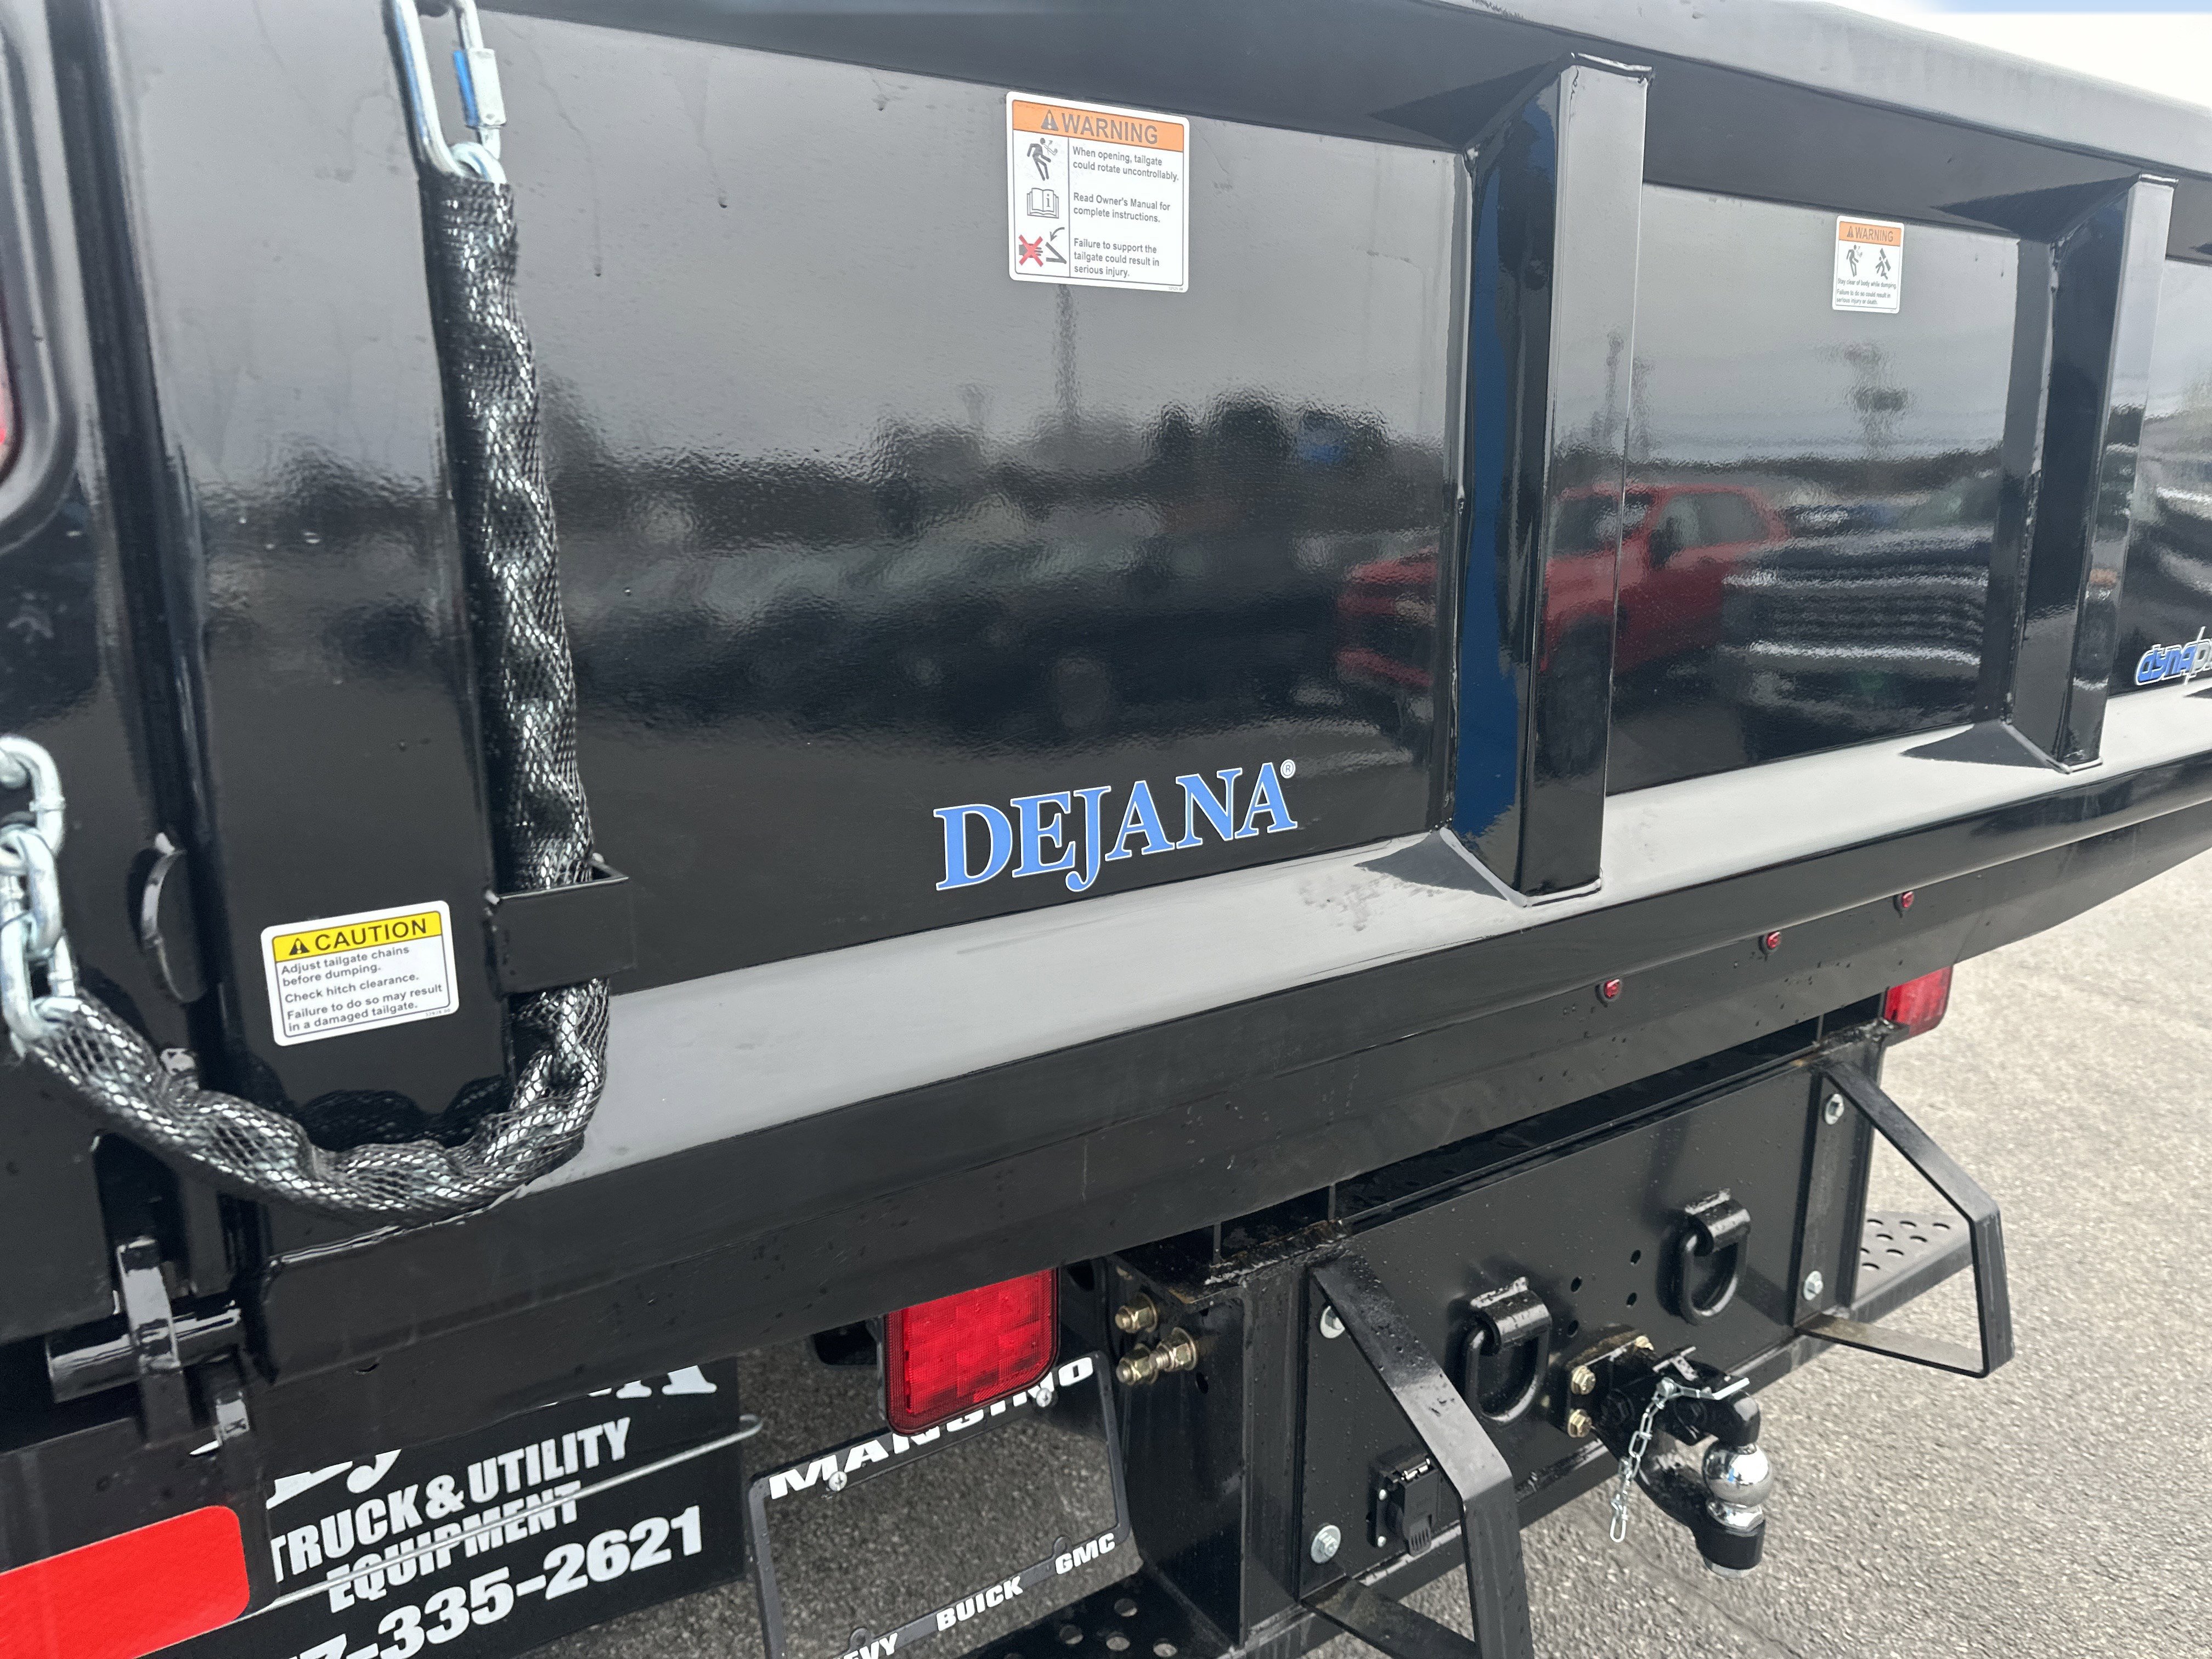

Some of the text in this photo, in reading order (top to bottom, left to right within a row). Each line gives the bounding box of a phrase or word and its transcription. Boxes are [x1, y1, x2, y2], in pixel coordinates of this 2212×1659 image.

[1061, 112, 1158, 144] WARNING
[1073, 146, 1162, 166] When opening, tailgate
[1073, 162, 1178, 182] could rotate uncontrollably.
[1074, 193, 1170, 211] Read Owner's Manual for
[1074, 207, 1160, 222] complete instructions.
[1074, 238, 1101, 249] Failure
[1113, 244, 1143, 253] support
[1145, 245, 1156, 253] the
[1855, 227, 1894, 242] WARNING
[1074, 251, 1159, 266] tailgate could result in
[1074, 266, 1129, 278] serious injury.
[315, 918, 426, 950] CAUTION
[281, 947, 409, 975] Adjust tailgate chains
[283, 964, 381, 987] before dumping.
[285, 974, 419, 1003] Check hitch clearance.
[287, 984, 442, 1020] Failure to do so may result
[289, 1023, 300, 1031] in
[314, 1010, 369, 1026] damaged
[372, 1002, 419, 1017] tailgate.
[269, 1485, 420, 1583] TRUCK
[425, 1473, 465, 1520] &
[467, 1416, 631, 1504] UTILITY
[326, 1480, 582, 1614] EQUIPMENT
[1054, 1532, 1116, 1575] GMC
[935, 1576, 1023, 1632] BUICK
